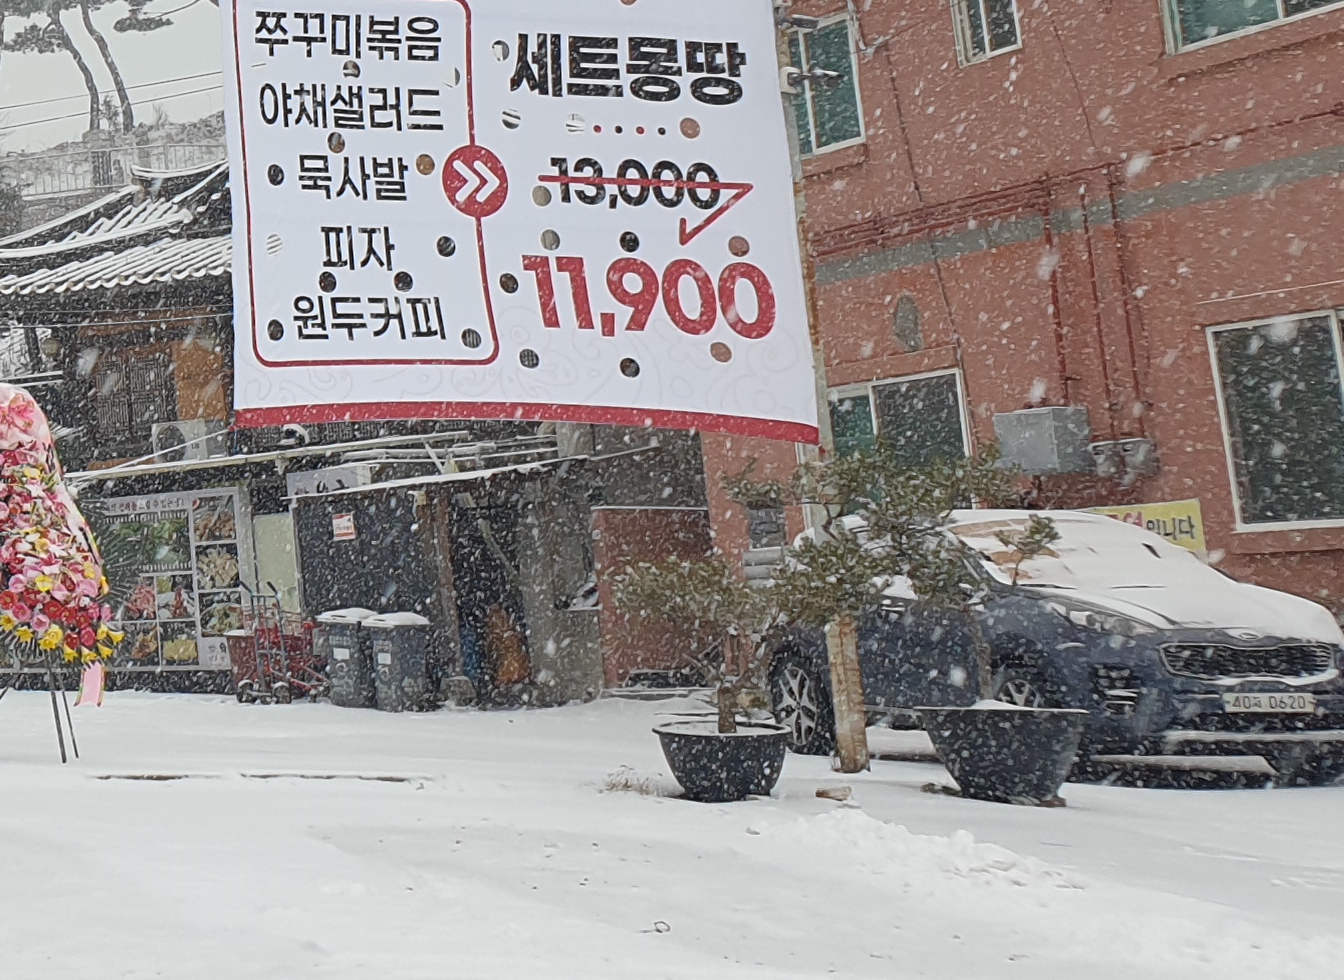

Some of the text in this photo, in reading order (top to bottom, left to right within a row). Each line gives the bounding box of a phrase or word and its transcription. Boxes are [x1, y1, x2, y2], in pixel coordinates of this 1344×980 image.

[253, 10, 443, 63] 쭈꾸미볶음
[509, 32, 747, 106] 세트몽땅
[258, 81, 445, 132] 야채샐러드
[297, 153, 409, 203] 묵사발
[549, 157, 721, 210] 13,000
[320, 225, 395, 272] 피자
[291, 295, 447, 342] 원두커피
[521, 254, 776, 341] 11,900
[1268, 695, 1306, 710] 0620
